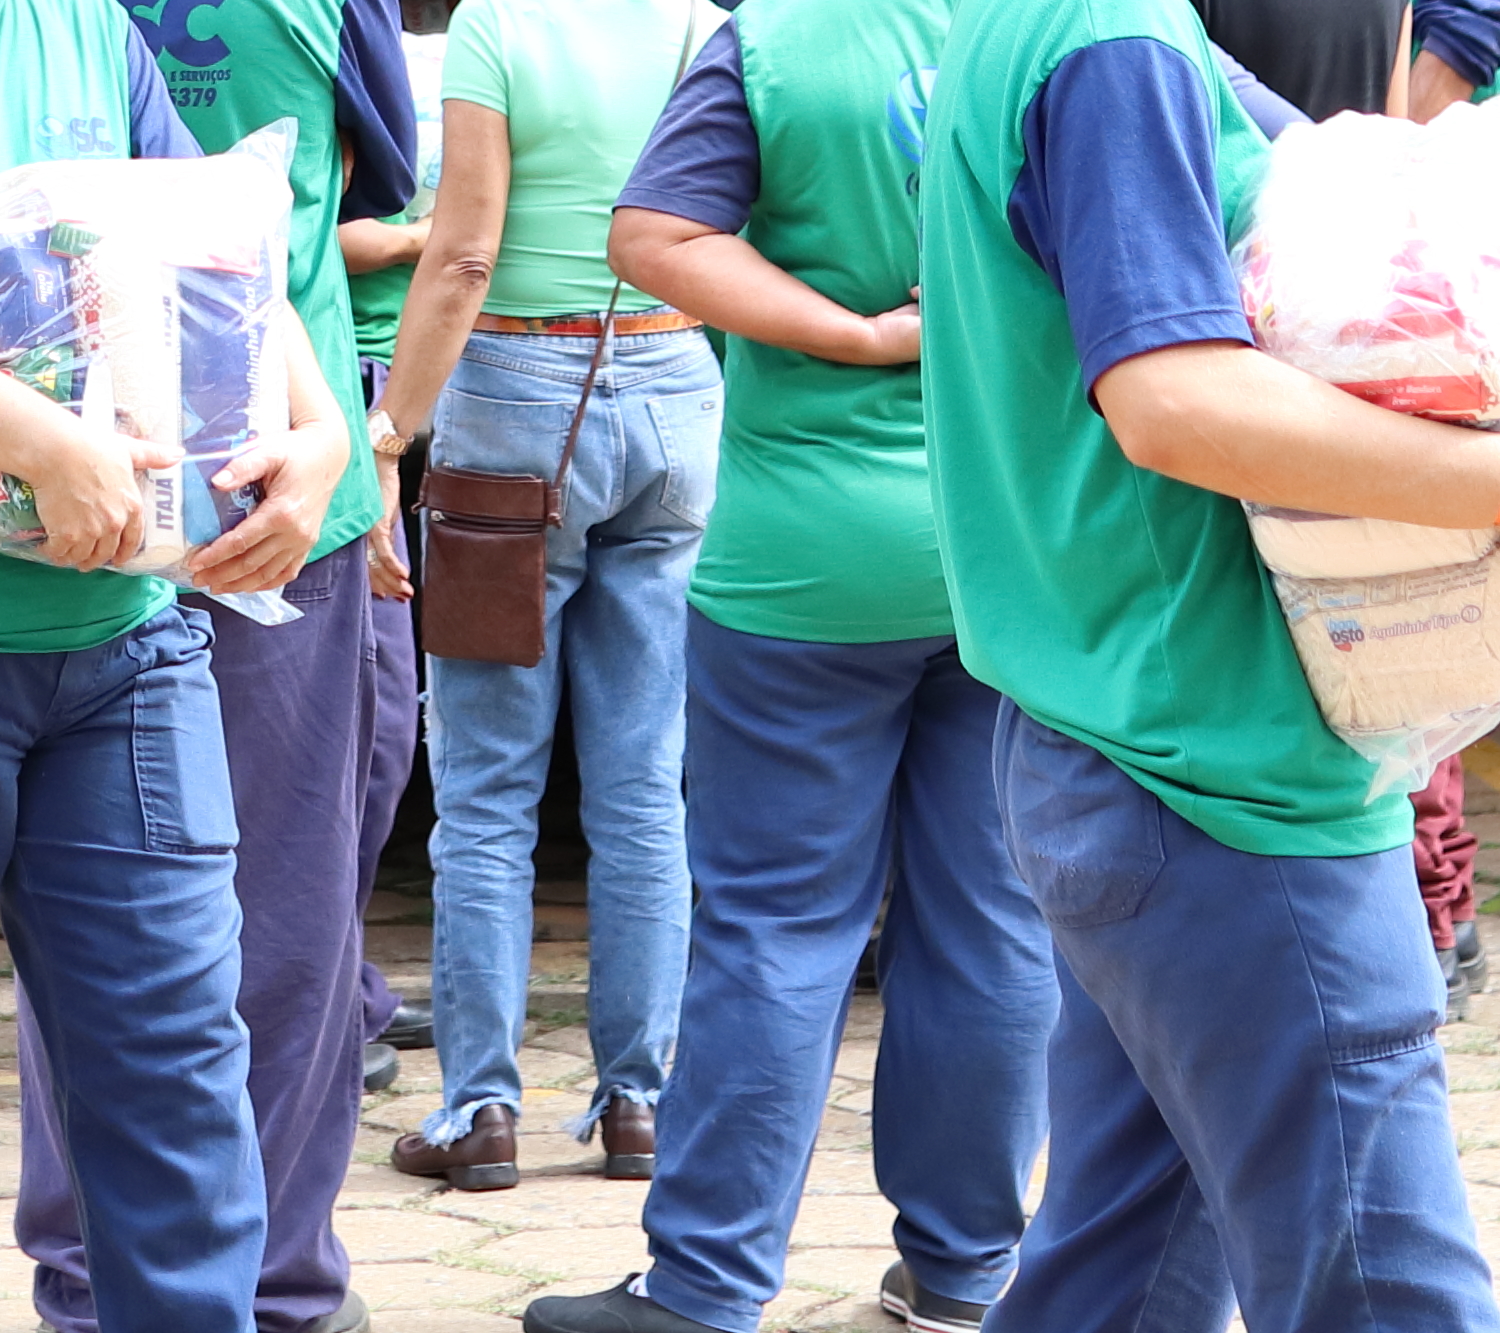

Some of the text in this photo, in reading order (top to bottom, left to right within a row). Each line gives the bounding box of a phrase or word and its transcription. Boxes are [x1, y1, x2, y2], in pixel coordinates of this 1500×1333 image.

[179, 69, 232, 84] SERVIÇOS
[69, 116, 116, 153] SC
[150, 478, 175, 531] ITAJÁ
